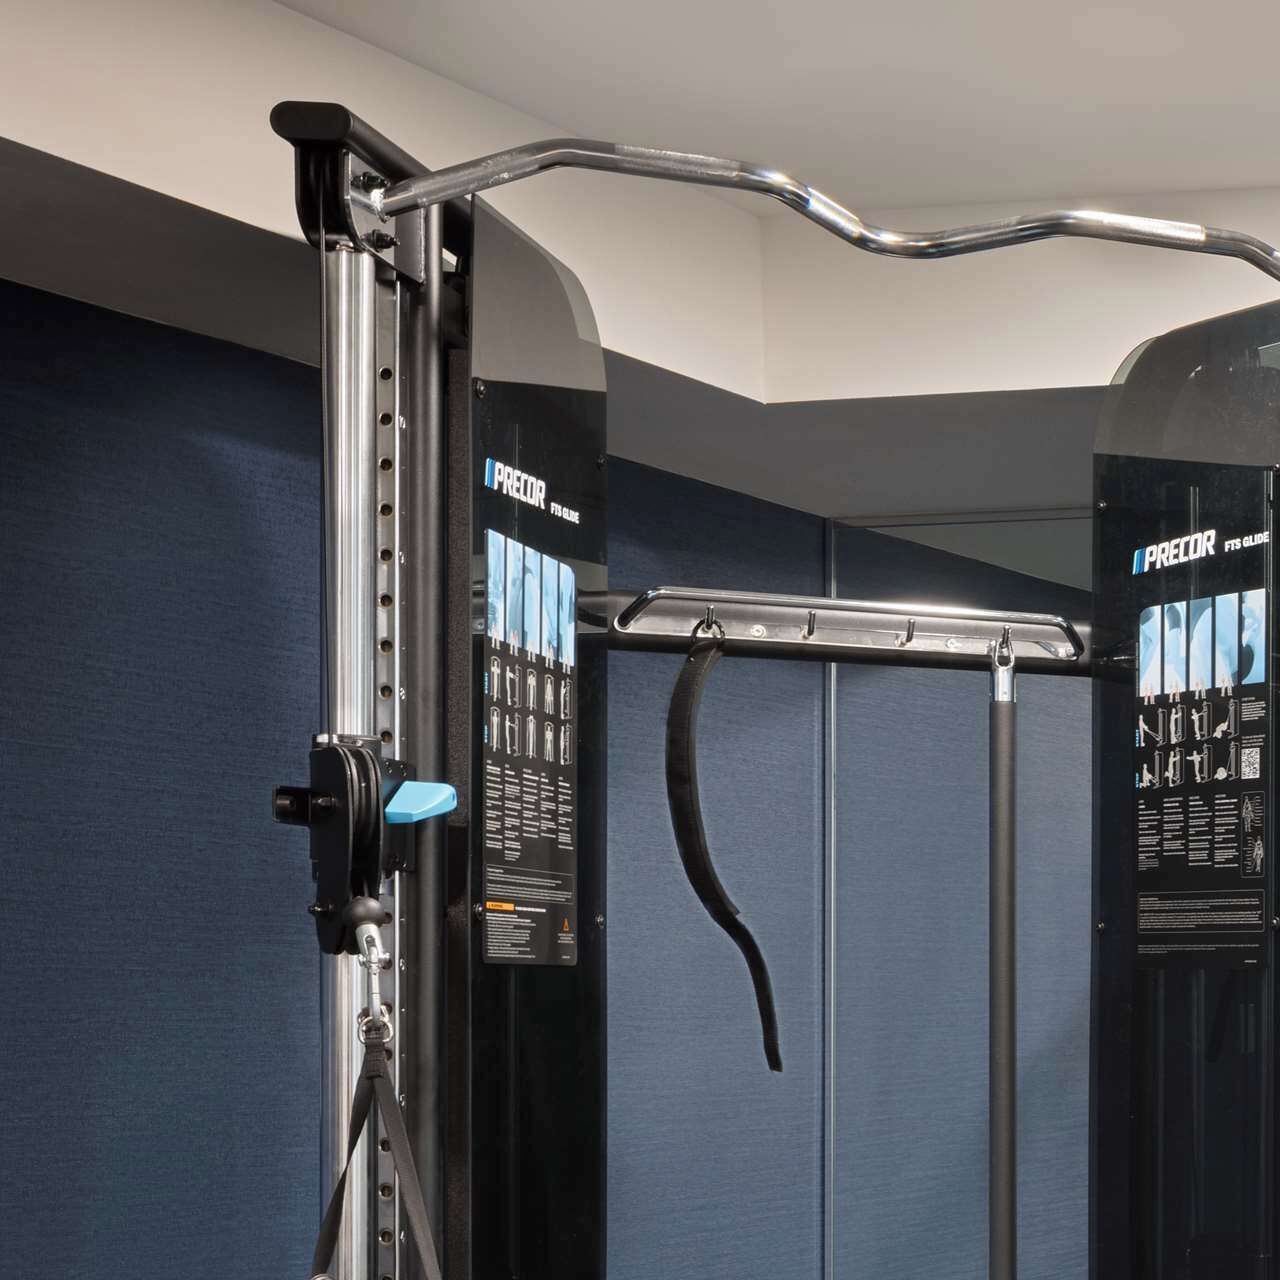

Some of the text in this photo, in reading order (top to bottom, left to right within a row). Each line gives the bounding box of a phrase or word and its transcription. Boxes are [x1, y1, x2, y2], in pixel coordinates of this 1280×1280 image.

[492, 461, 580, 524] PRECOR FTS GLIDE
[1143, 529, 1270, 573] PRECOR FTS GLIDE
